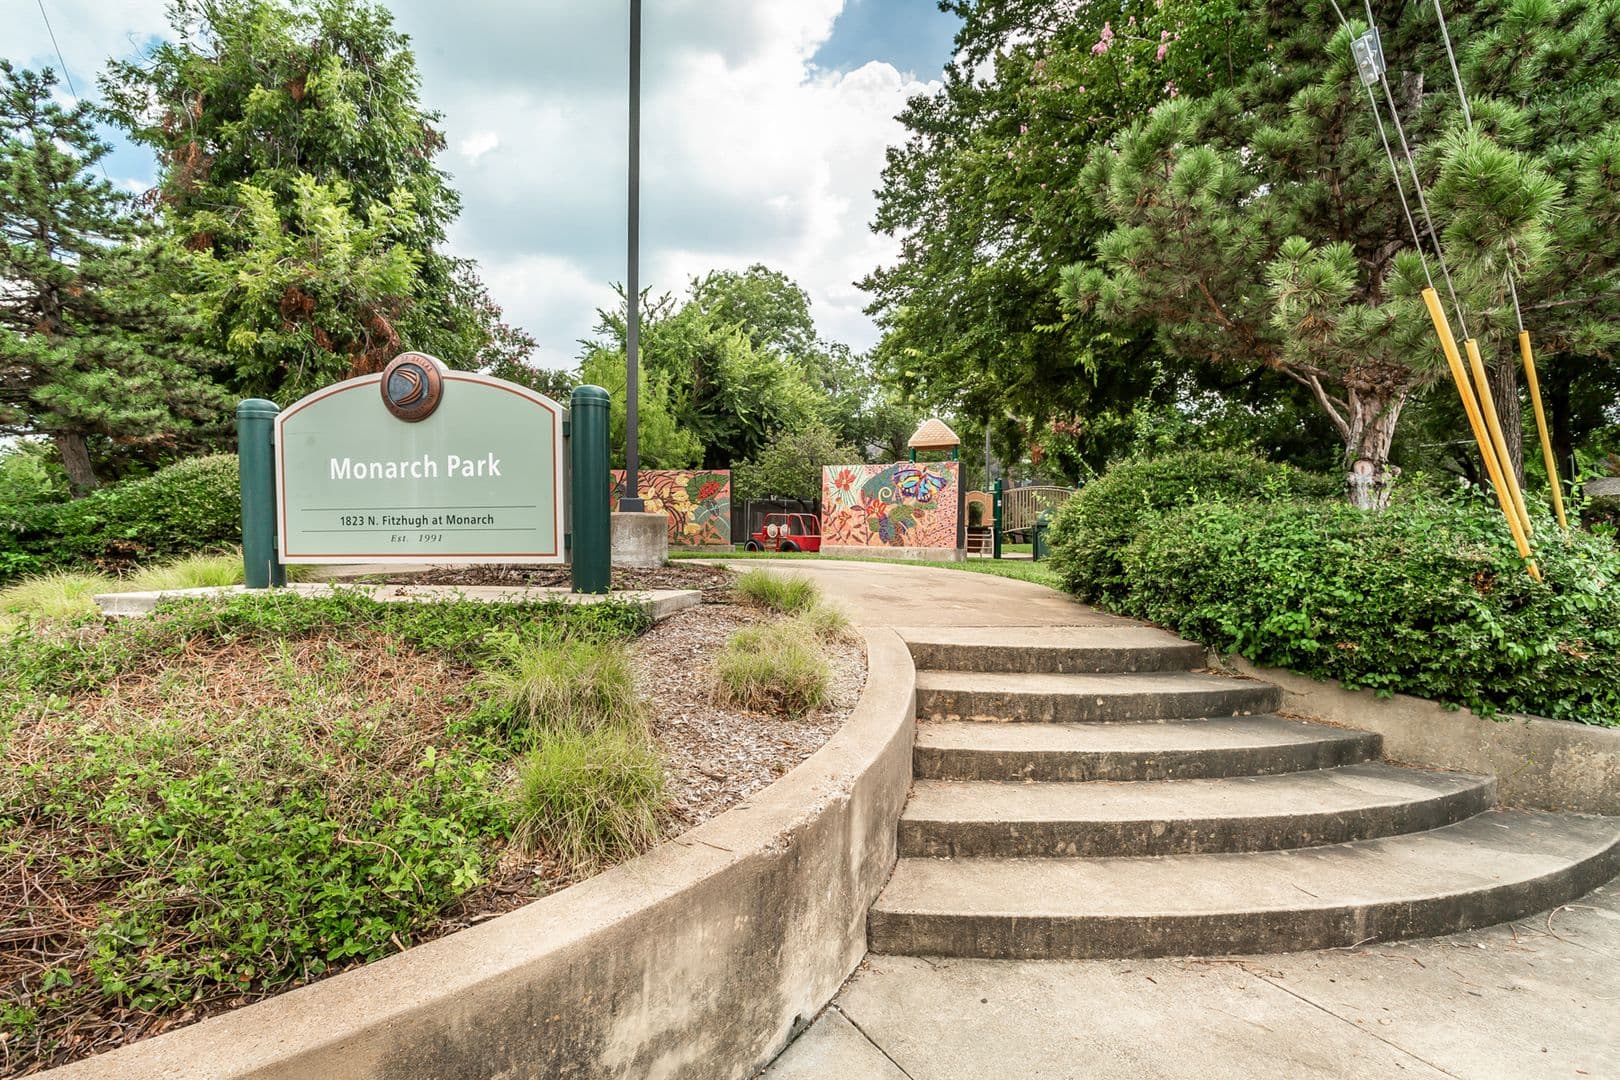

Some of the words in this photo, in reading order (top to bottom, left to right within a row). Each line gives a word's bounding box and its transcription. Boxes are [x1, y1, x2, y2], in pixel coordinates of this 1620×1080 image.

[330, 454, 438, 480] Monarch
[447, 452, 502, 478] Park
[340, 516, 365, 526] 1823
[368, 515, 379, 526] N.
[382, 515, 429, 528] Fitzhugh
[432, 516, 442, 525] at
[446, 514, 494, 525] Monarch
[390, 534, 409, 543] Est.
[418, 534, 443, 543] 1991
